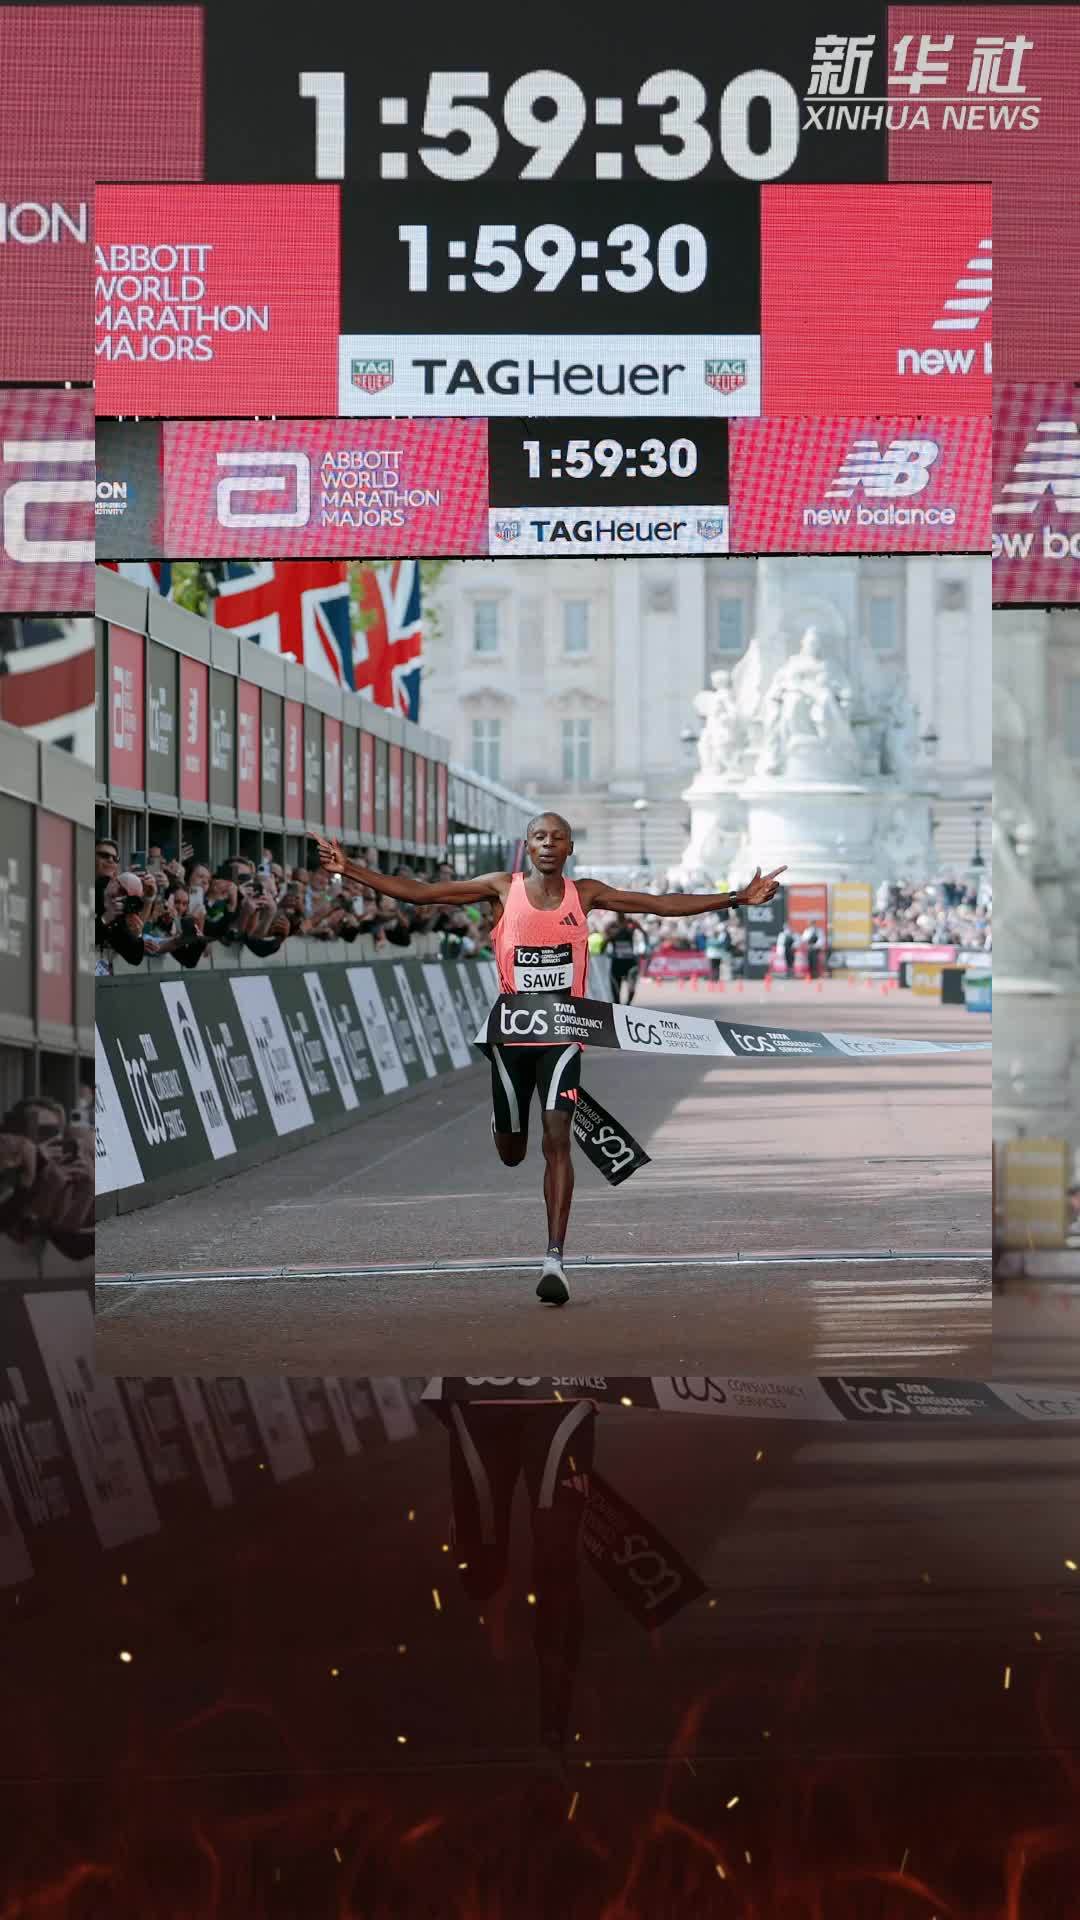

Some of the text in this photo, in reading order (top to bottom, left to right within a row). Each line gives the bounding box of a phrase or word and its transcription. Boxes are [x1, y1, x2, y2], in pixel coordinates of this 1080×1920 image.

[299, 69, 800, 182] 1:59:30
[398, 223, 708, 293] 1:59:30
[898, 348, 976, 376] new
[321, 451, 403, 470] ABBOTT
[523, 438, 698, 479] 1:59:30
[321, 471, 399, 488] WORLD
[321, 491, 440, 507] MARATHON
[321, 510, 405, 527] MAJORS
[803, 504, 956, 525] new balance
[516, 949, 540, 964] tcs
[523, 972, 566, 988] SAWE
[553, 1002, 577, 1014] TATA
[500, 1002, 549, 1035] tcs
[553, 1014, 604, 1030] CONSULTANCY
[659, 1020, 680, 1030] TATA
[553, 1025, 590, 1037] SERVICES
[625, 1014, 663, 1046] tcs
[729, 1029, 777, 1053] tcs
[591, 1125, 635, 1174] tcs
[837, 1377, 912, 1415] tcs
